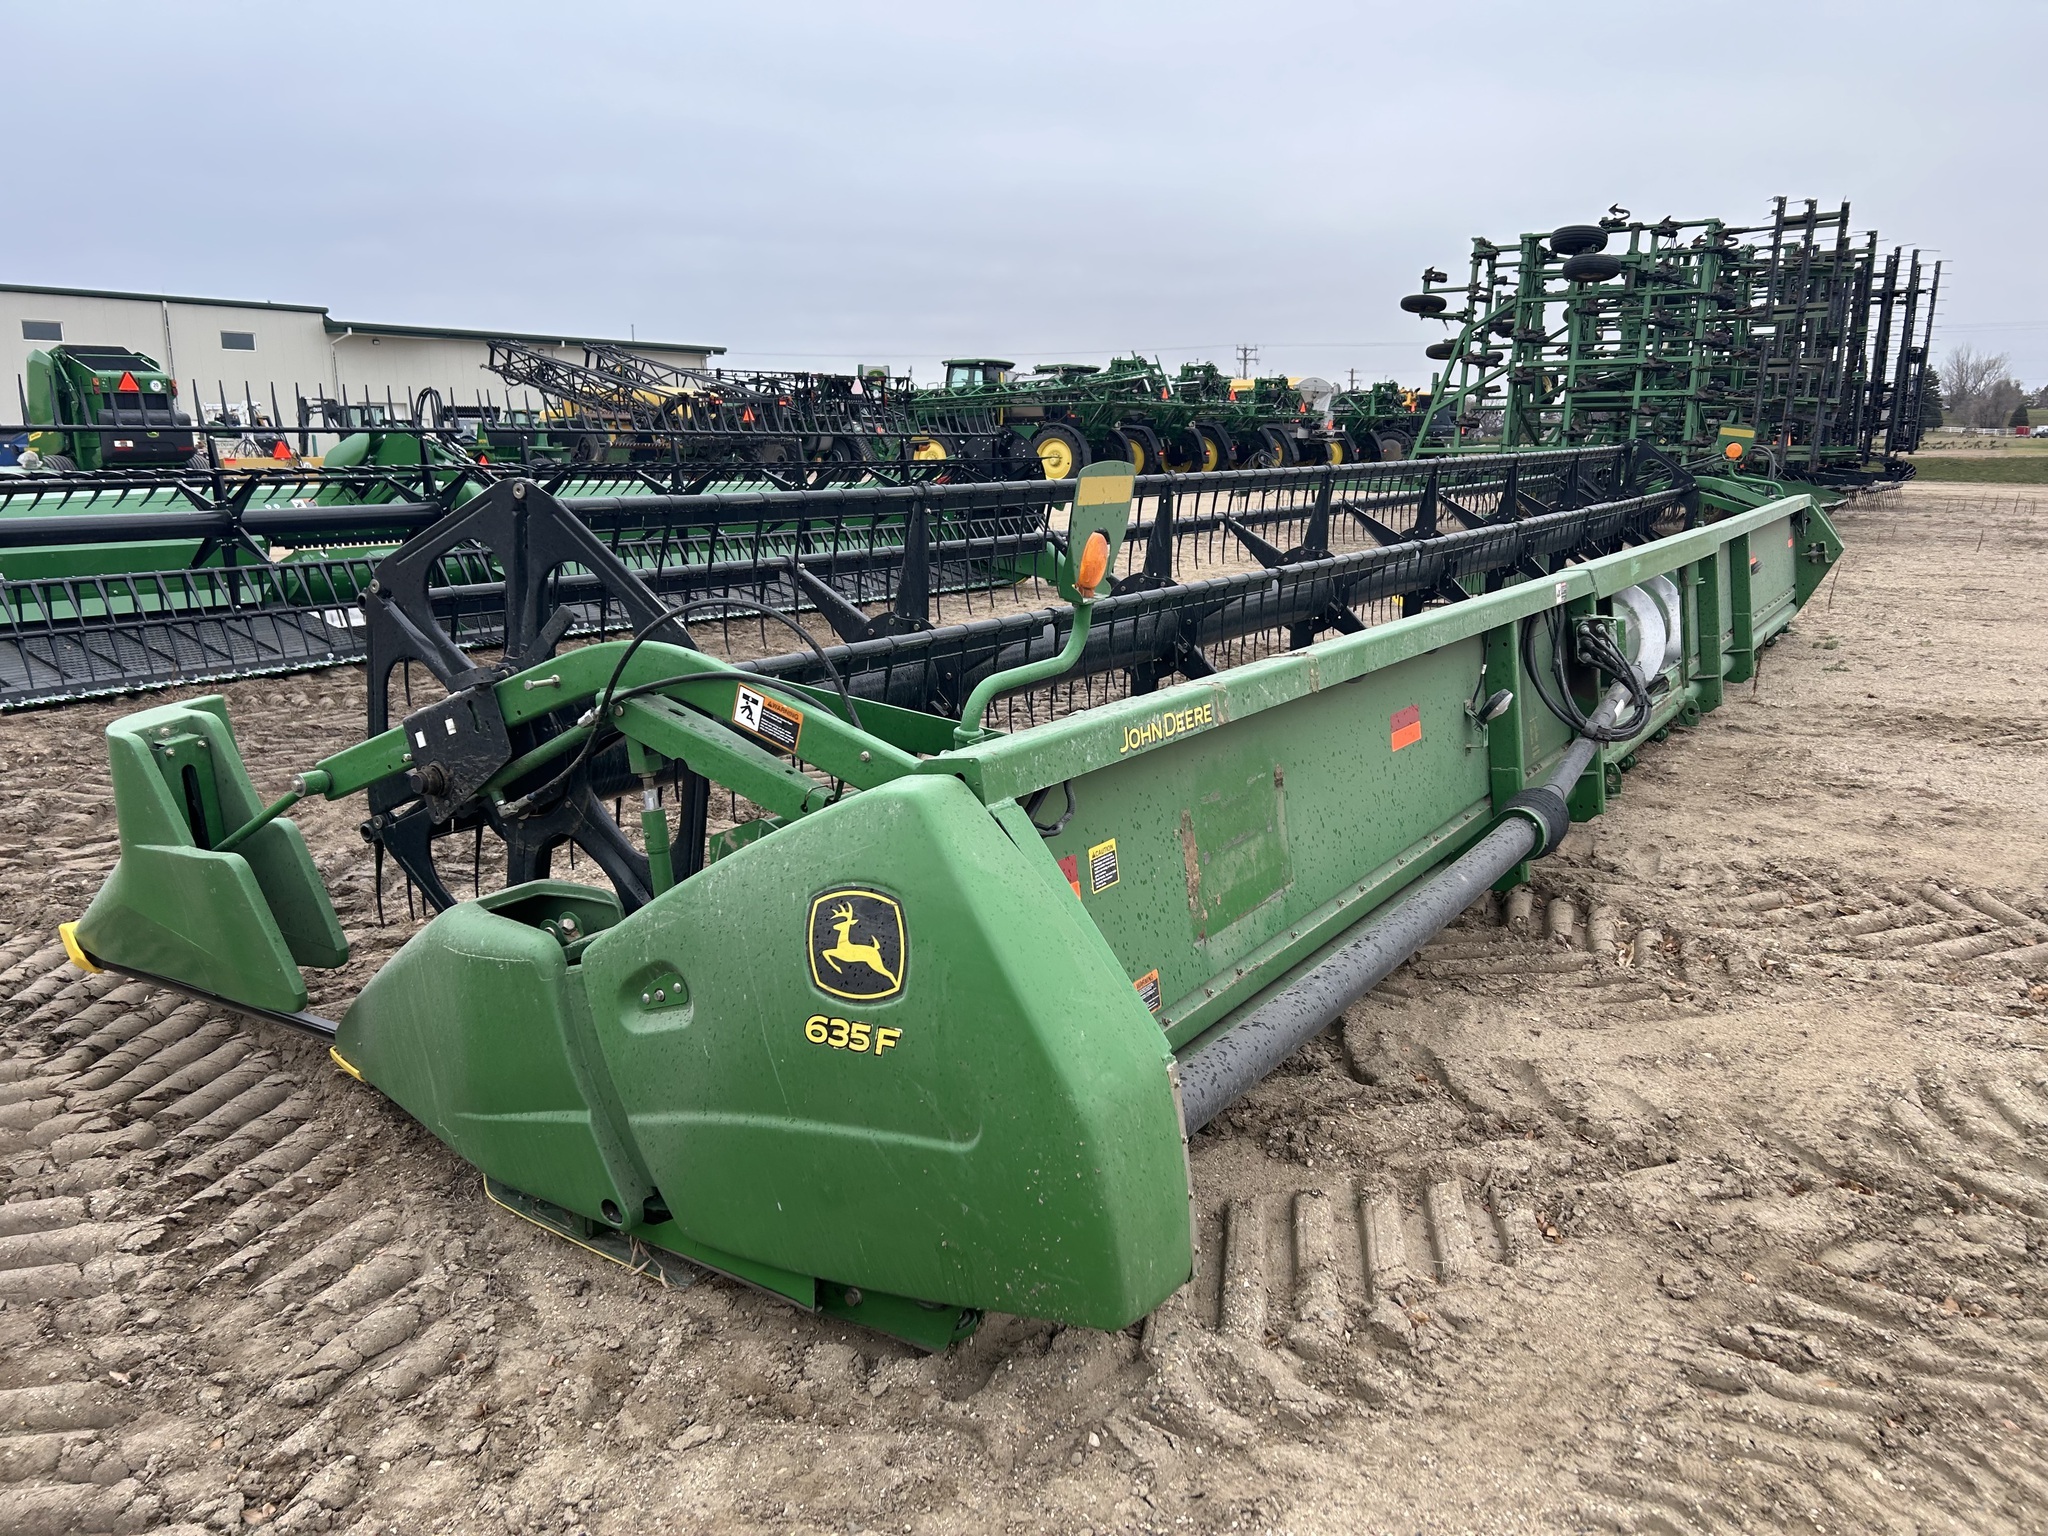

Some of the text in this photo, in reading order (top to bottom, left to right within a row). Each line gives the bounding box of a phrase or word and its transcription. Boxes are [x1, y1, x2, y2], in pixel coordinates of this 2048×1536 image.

[772, 703, 799, 721] WARNING
[1120, 703, 1213, 753] JOHN DEERE
[1095, 845, 1114, 857] CAUTION
